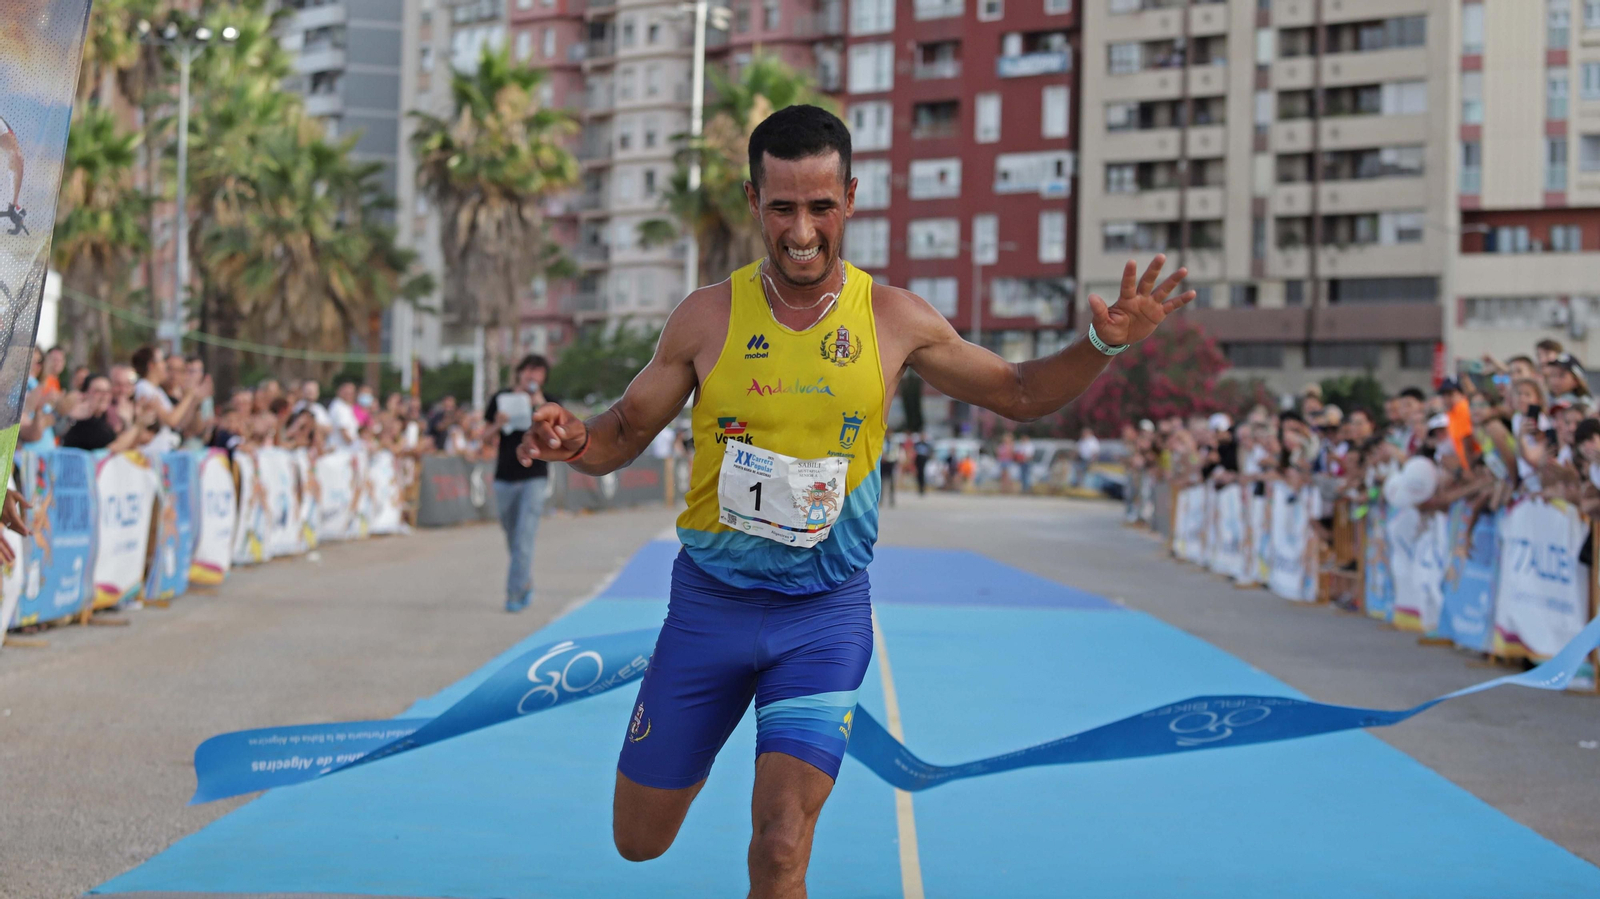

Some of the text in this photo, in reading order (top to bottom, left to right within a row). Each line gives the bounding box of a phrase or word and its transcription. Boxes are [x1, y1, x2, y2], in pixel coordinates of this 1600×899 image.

[746, 377, 836, 397] Andalucía
[735, 449, 752, 467] XX
[750, 461, 773, 473] Popular
[752, 454, 774, 465] Carrera
[749, 481, 763, 511] 1
[251, 755, 313, 773] Algeciras
[316, 753, 332, 767] de
